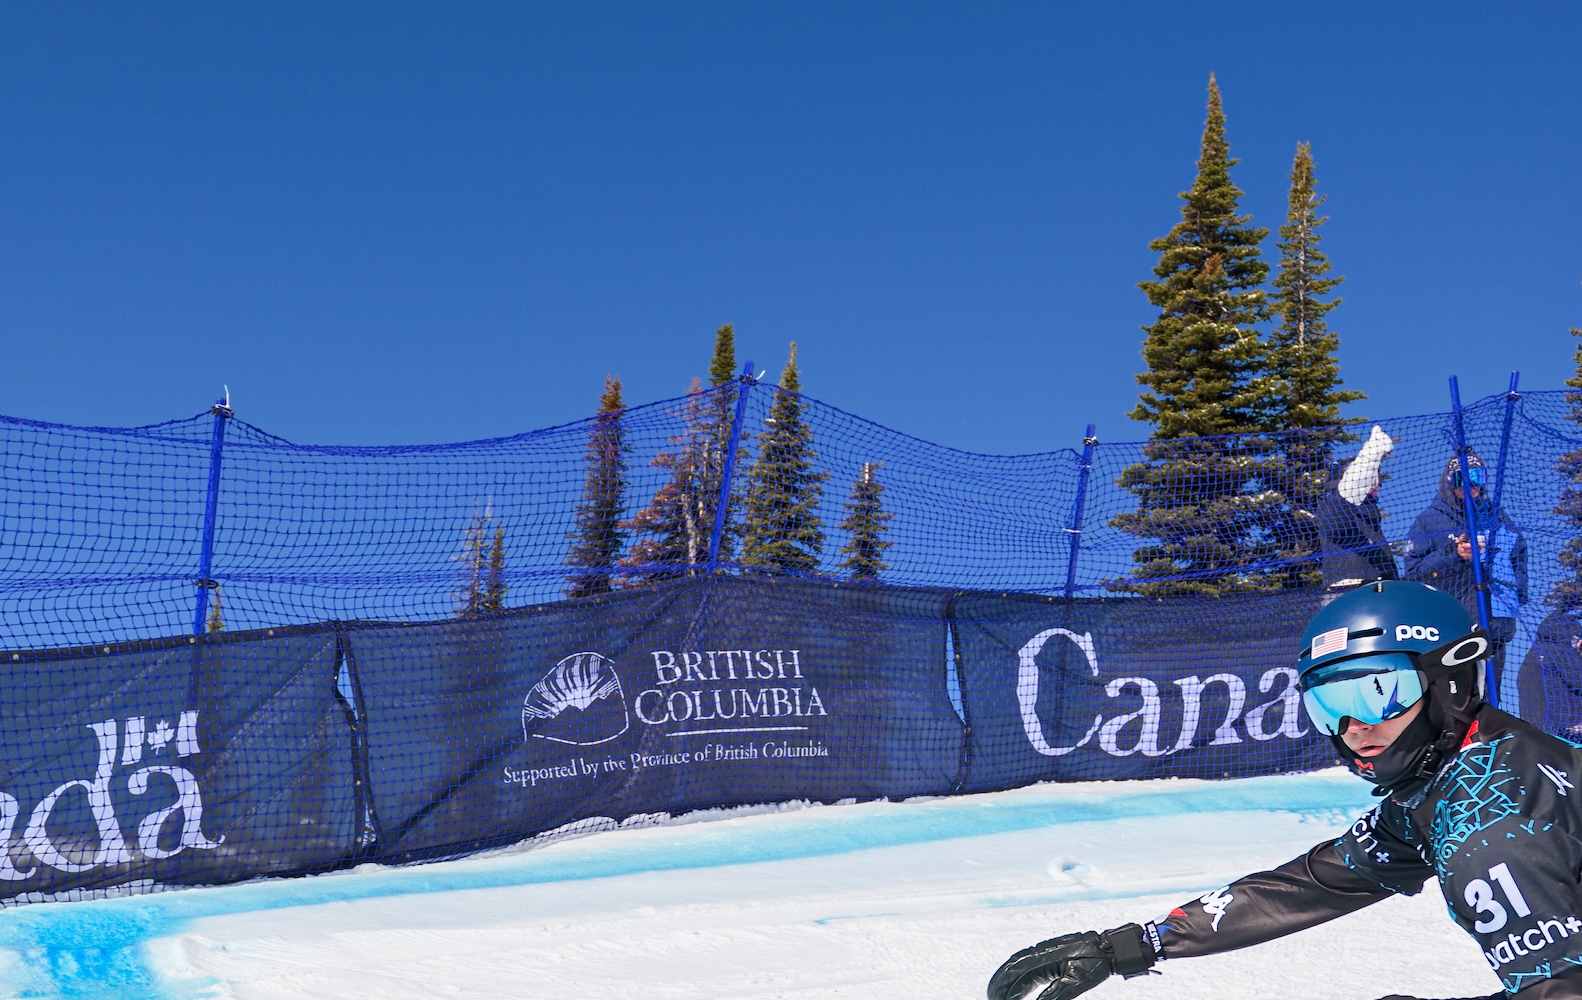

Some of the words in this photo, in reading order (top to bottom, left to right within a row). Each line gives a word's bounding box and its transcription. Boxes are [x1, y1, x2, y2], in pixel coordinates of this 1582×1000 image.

[1395, 624, 1440, 641] poc
[651, 649, 804, 686] BRITISH
[634, 686, 828, 725] COLUMBIA
[1017, 627, 1309, 757] Cana
[503, 759, 577, 788] Supported
[580, 757, 599, 779] by
[603, 755, 626, 771] the
[630, 750, 690, 770] Province
[694, 743, 713, 762] of
[715, 742, 759, 761] British
[762, 740, 829, 759] Columbia
[1463, 862, 1532, 934] 31
